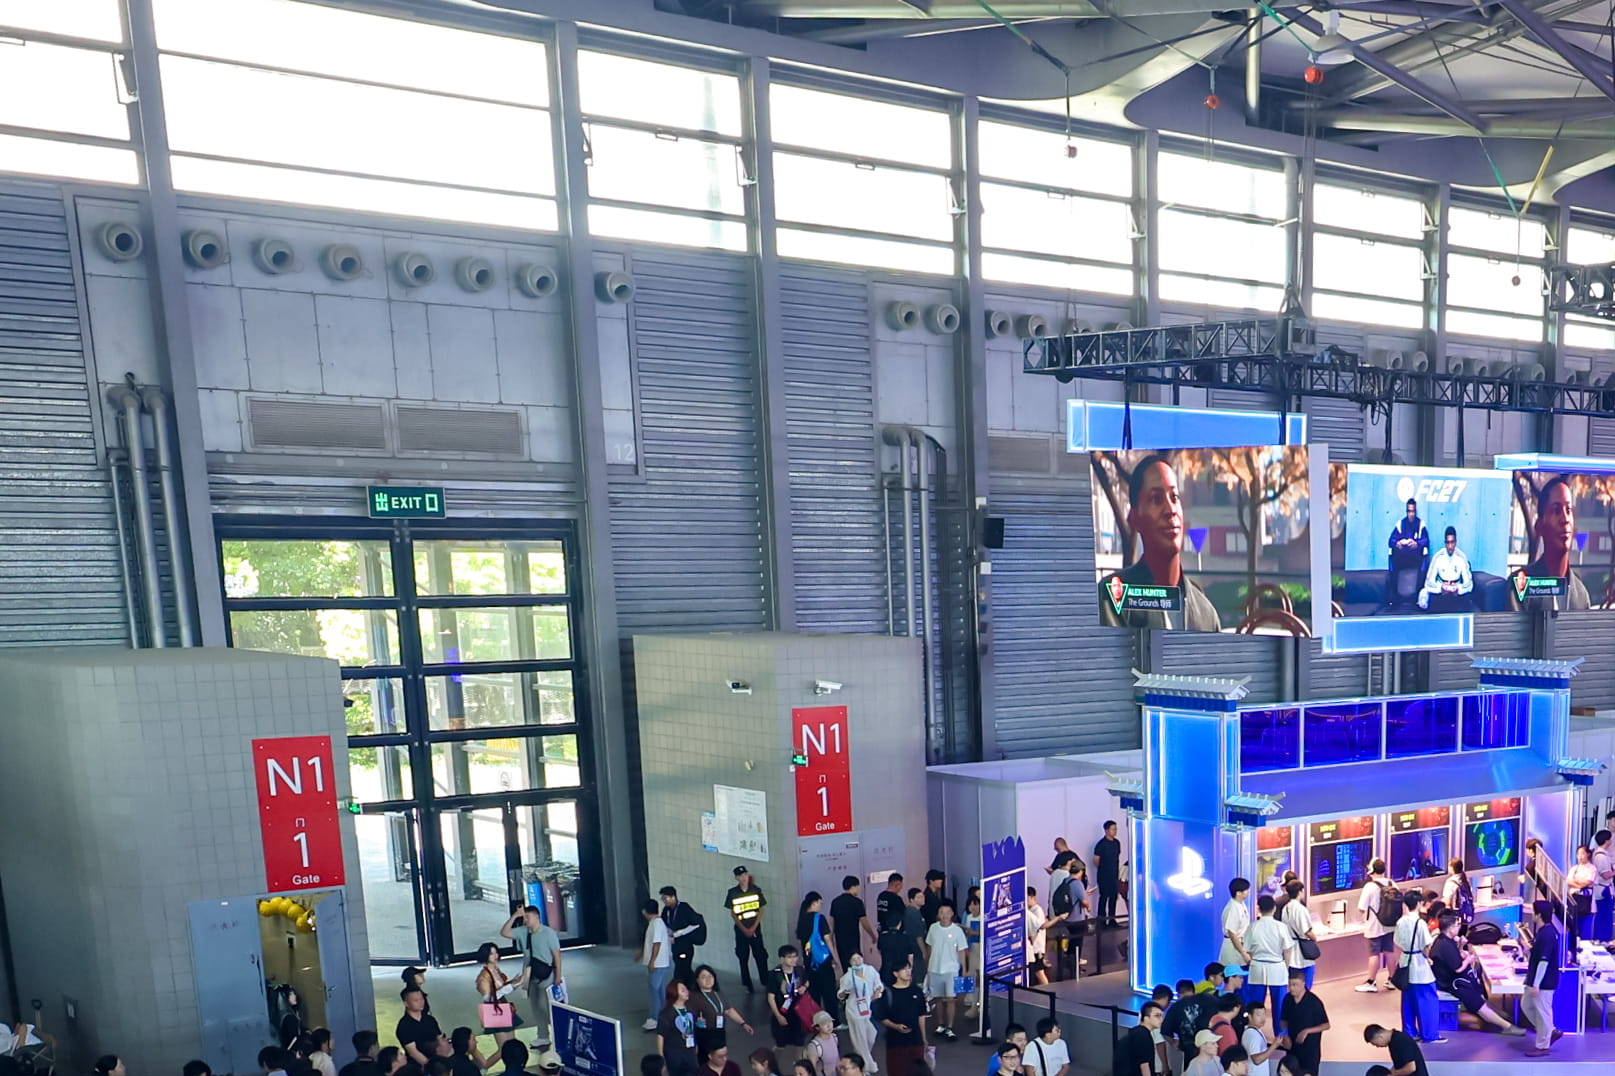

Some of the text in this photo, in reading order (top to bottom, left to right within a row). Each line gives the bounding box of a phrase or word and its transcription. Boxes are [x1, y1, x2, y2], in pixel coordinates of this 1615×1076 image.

[614, 443, 634, 461] 12
[1413, 480, 1467, 502] FC27
[375, 493, 438, 512] 出 EXIT 口
[1128, 588, 1167, 597] ALEX HUNTER
[1129, 598, 1137, 606] The
[802, 723, 841, 755] N1
[267, 756, 325, 796] N1
[817, 786, 828, 816] 1
[815, 822, 835, 831] Gate
[294, 832, 310, 867] 1
[292, 874, 320, 885] Gate
